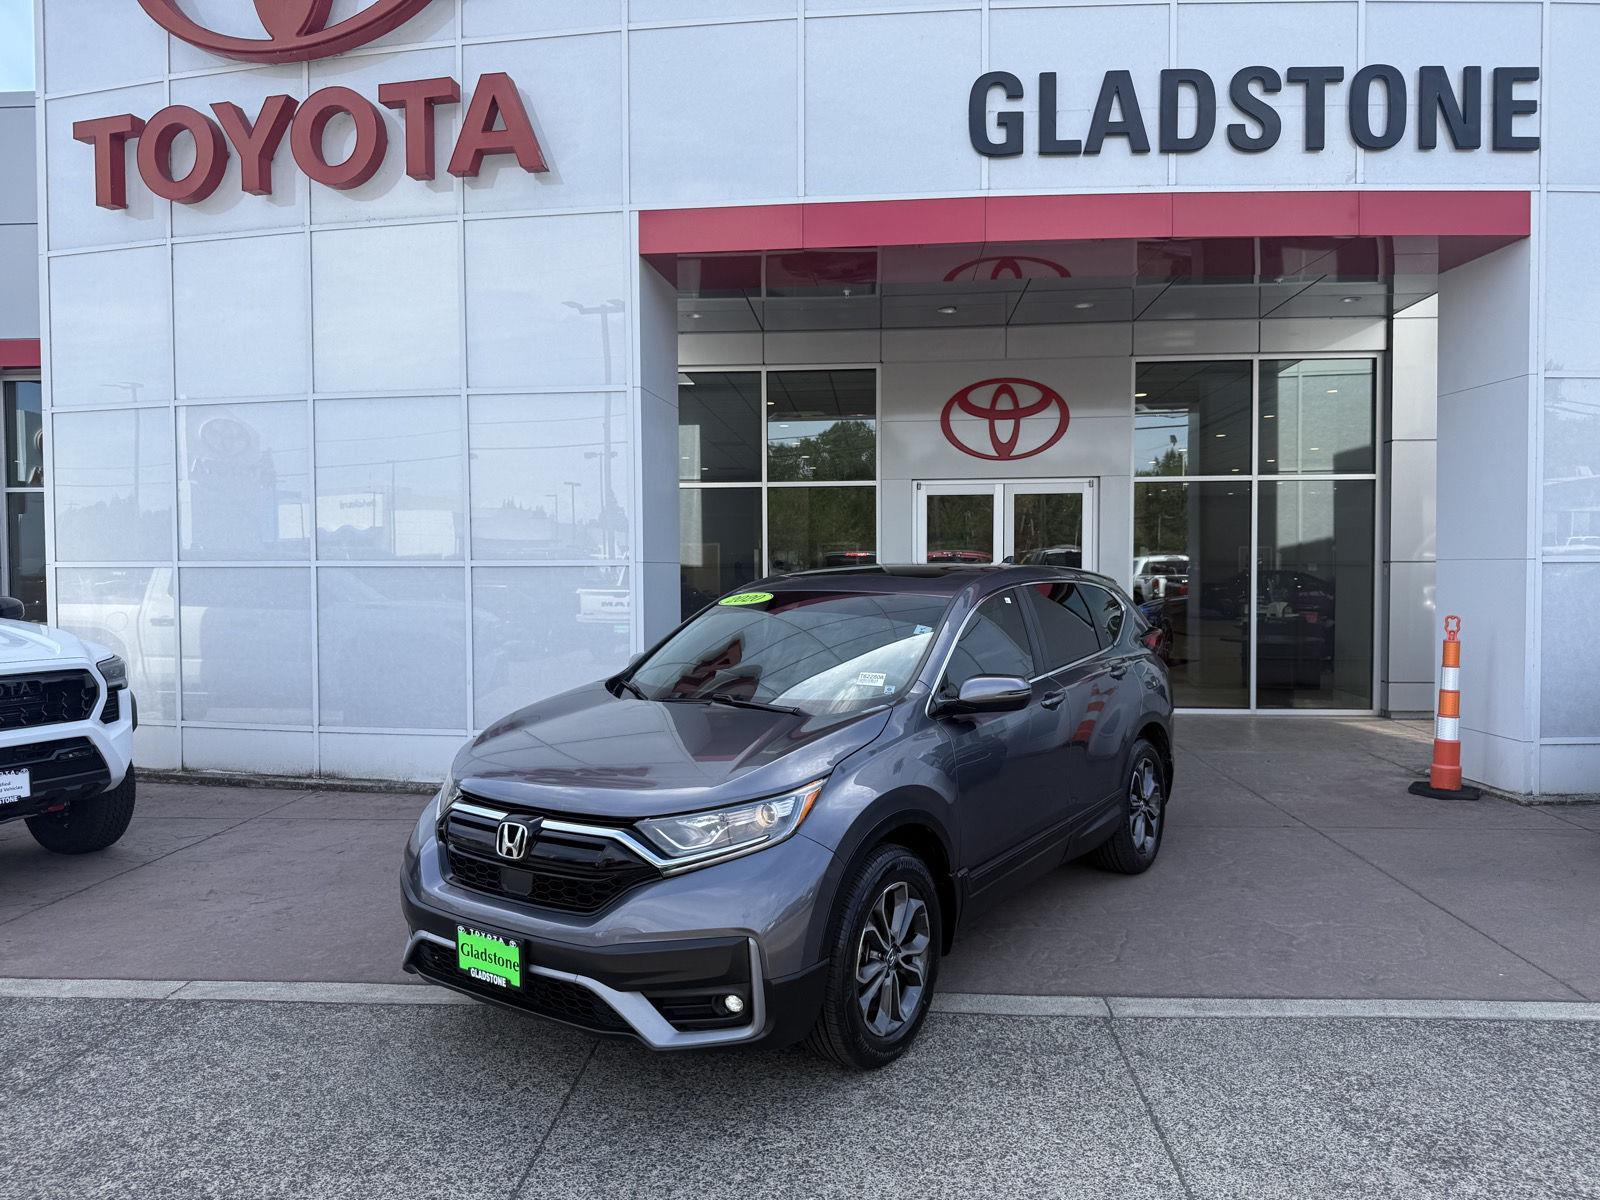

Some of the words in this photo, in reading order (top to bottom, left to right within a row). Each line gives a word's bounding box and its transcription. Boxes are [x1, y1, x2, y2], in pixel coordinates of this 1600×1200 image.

[968, 64, 1541, 157] GLADSTONE
[72, 72, 550, 210] TOYOTA
[724, 594, 767, 604] 2020
[469, 928, 505, 944] TOYOTA
[460, 942, 520, 972] Gladstone
[470, 967, 507, 988] GLADSTONE
